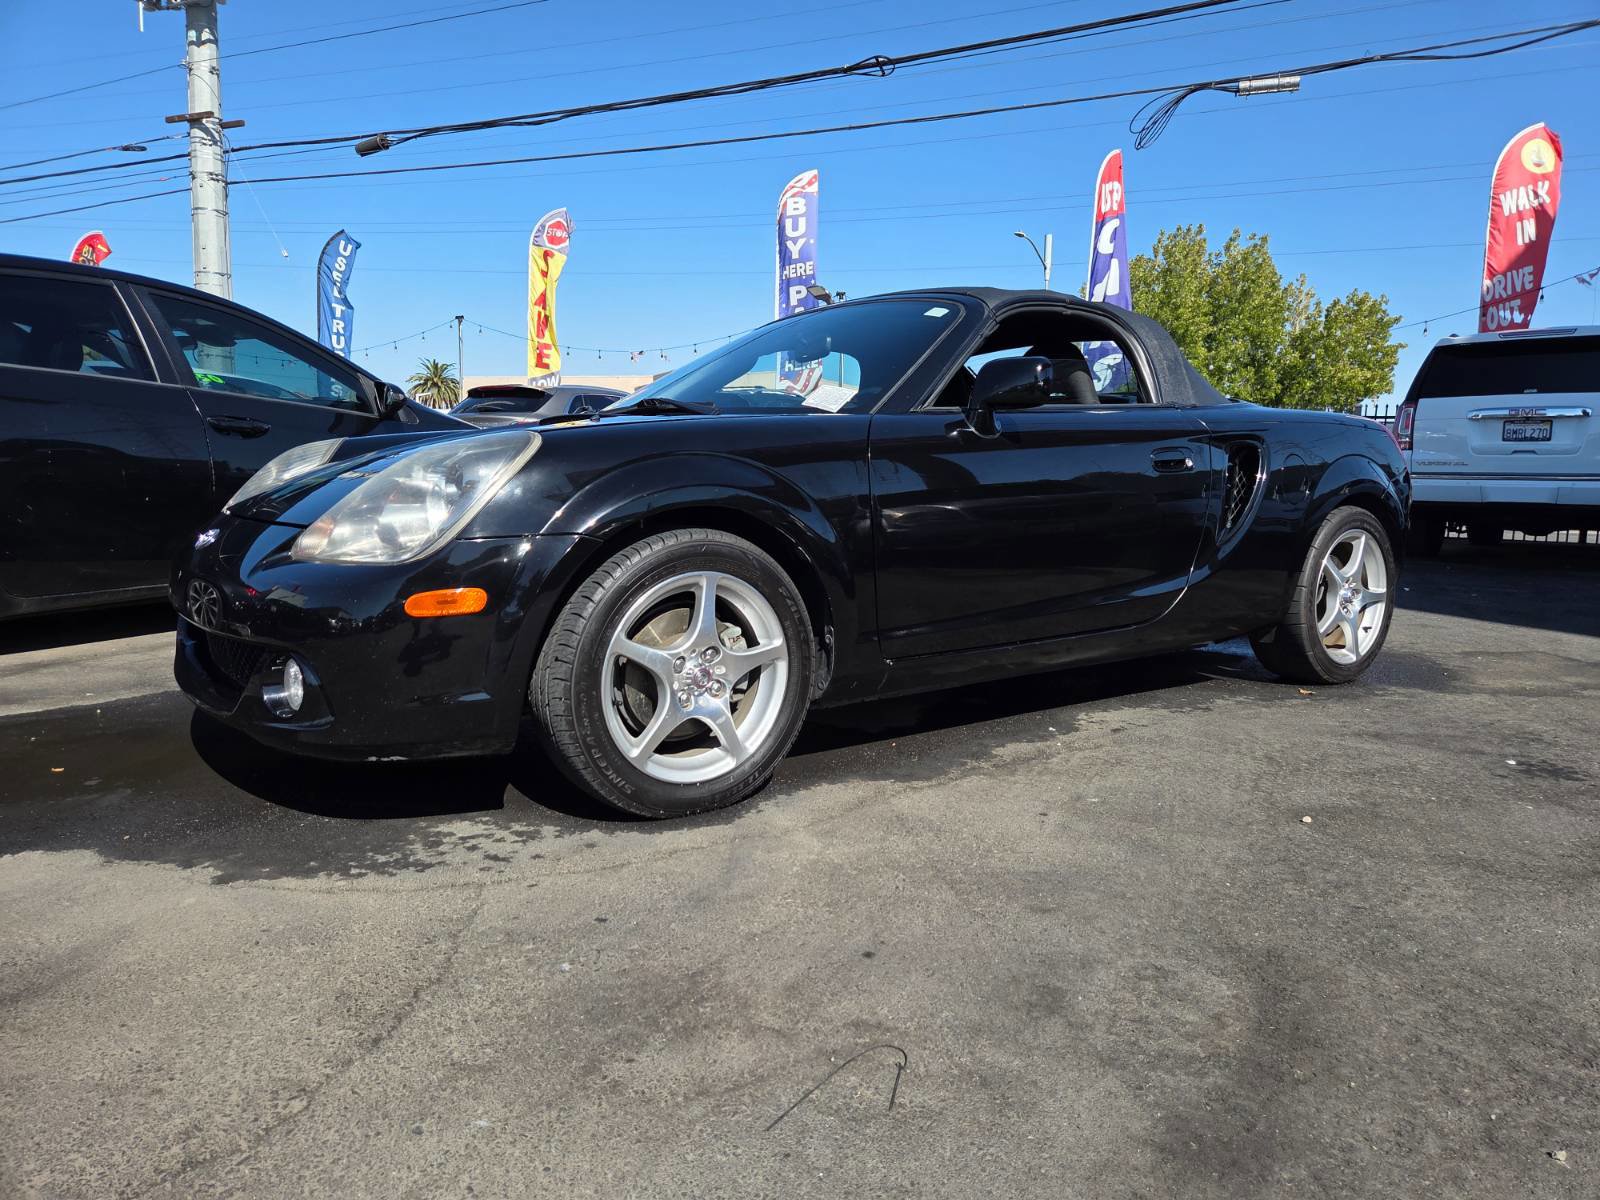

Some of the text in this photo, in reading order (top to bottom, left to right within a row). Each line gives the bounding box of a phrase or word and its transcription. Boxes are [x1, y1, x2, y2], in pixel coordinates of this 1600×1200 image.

[1499, 180, 1550, 217] WALK
[785, 196, 807, 260] BUY
[1516, 218, 1537, 246] IN
[783, 261, 814, 280] HERE
[1483, 265, 1534, 303] DRIVE
[1509, 408, 1547, 416] GMC
